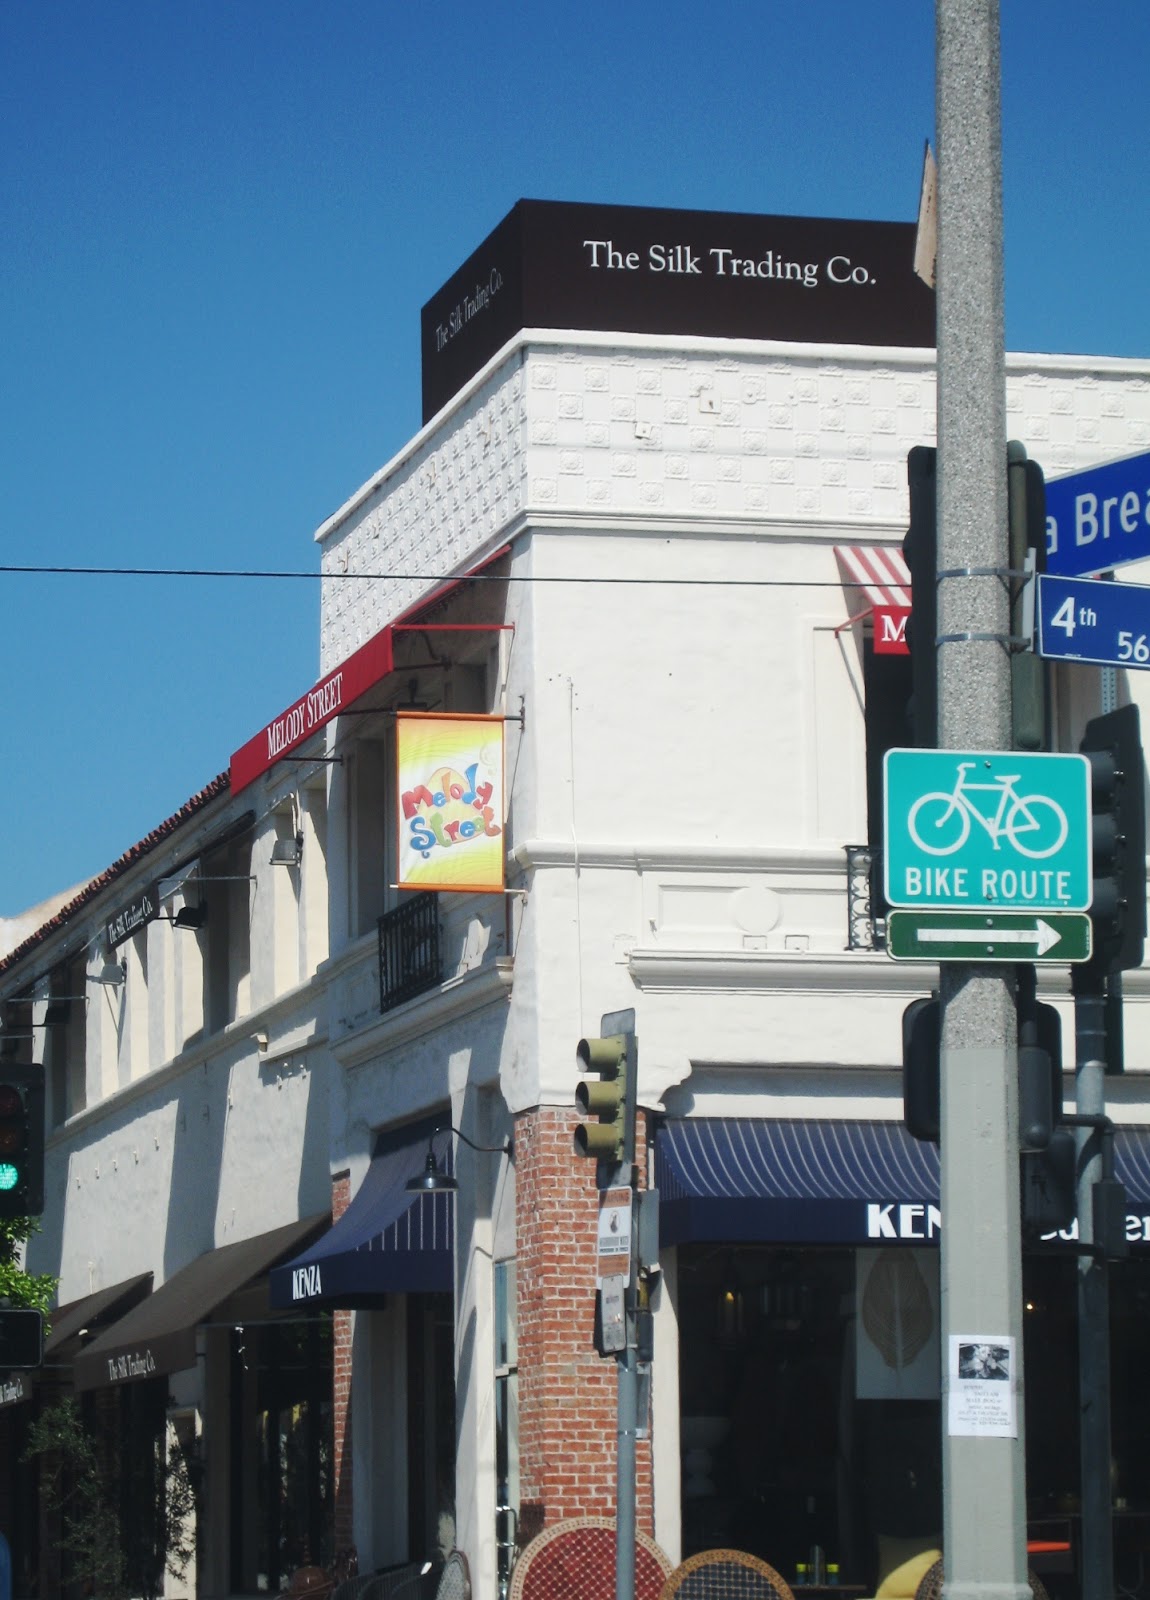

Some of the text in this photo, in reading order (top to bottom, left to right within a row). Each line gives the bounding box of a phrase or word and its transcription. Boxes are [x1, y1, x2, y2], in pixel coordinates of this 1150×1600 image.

[583, 240, 877, 287] The Silk Trading Co.
[436, 324, 449, 352] The
[450, 304, 463, 338] Silk
[464, 285, 490, 323] Trading
[1050, 596, 1097, 638] 4th
[1117, 630, 1150, 662] 56
[267, 672, 343, 760] MELODY STREET
[401, 762, 502, 860] Melody Street
[905, 866, 1072, 900] BIKE ROUTE
[292, 1264, 322, 1300] KENZA
